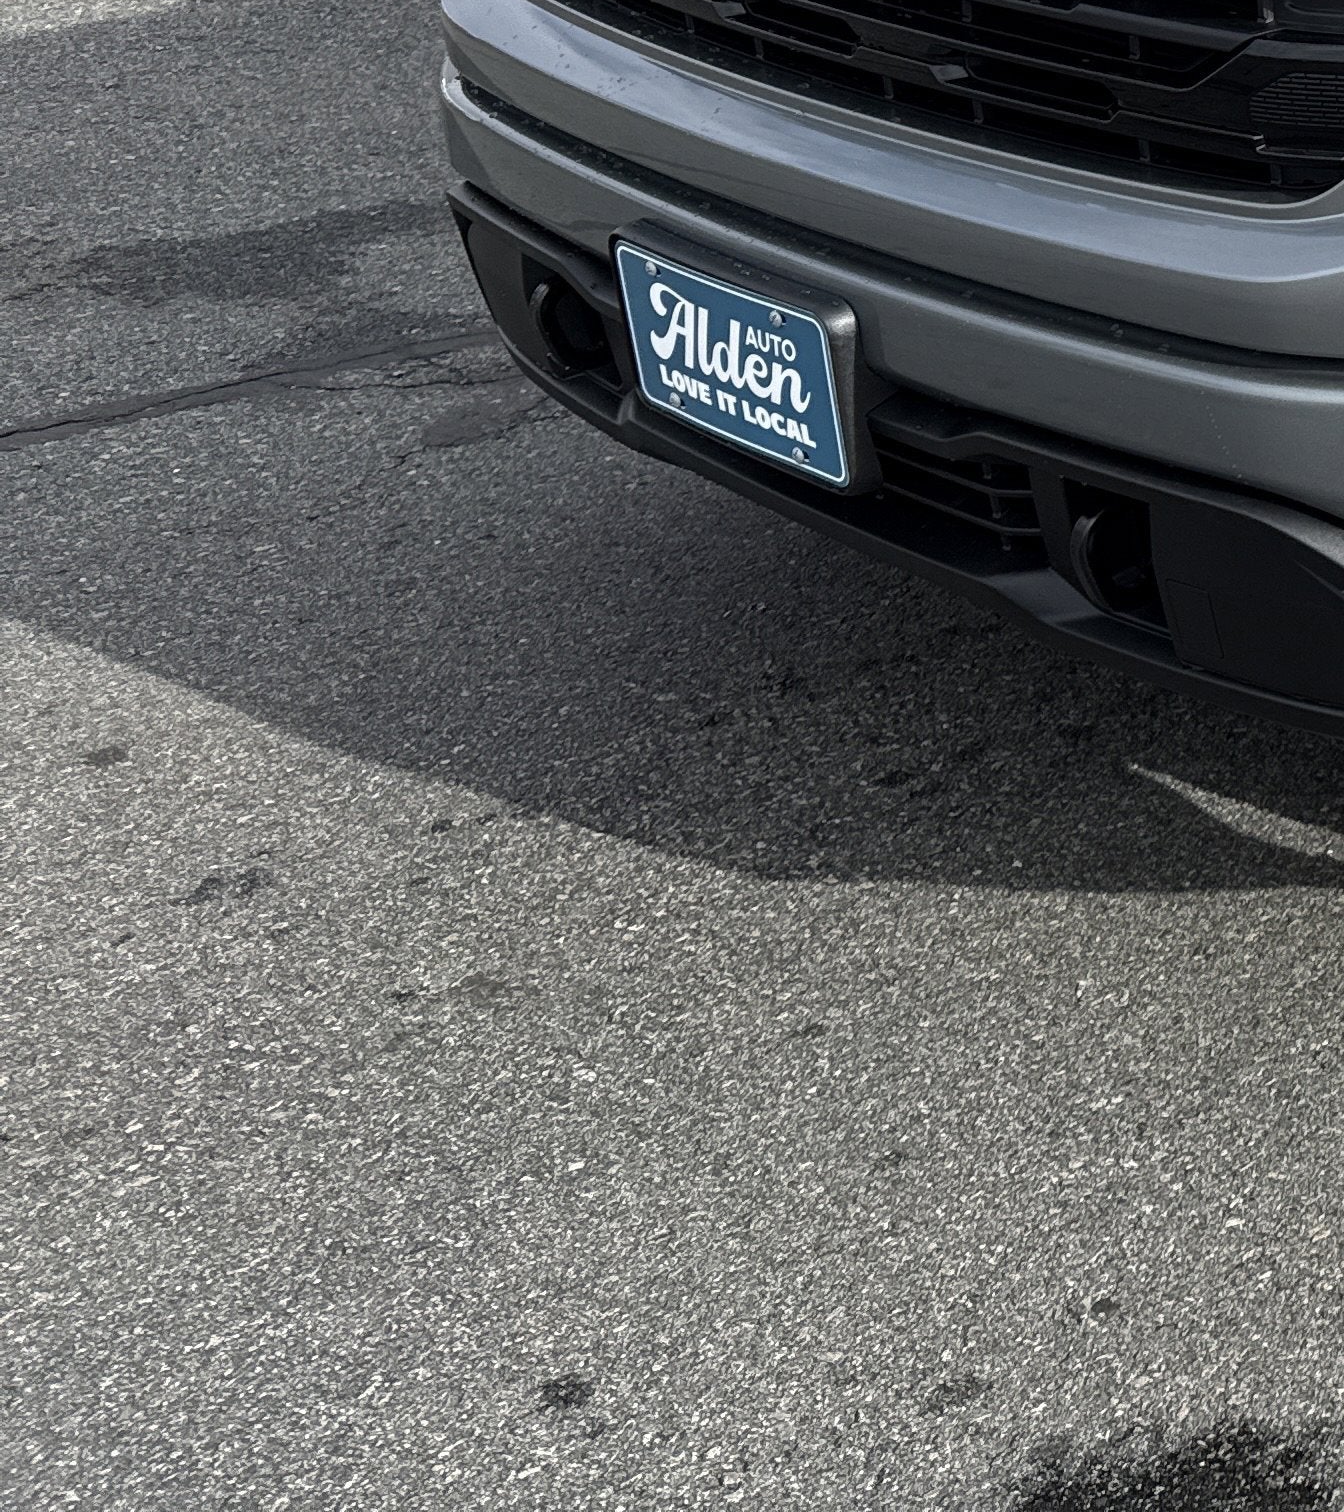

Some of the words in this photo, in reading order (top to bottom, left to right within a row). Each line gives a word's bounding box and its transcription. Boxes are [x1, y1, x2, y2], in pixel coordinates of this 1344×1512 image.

[650, 282, 811, 413] Alden
[745, 326, 796, 362] AUTO
[659, 364, 713, 406] LOVE
[716, 389, 740, 417] IT
[741, 400, 817, 449] LOCAL
